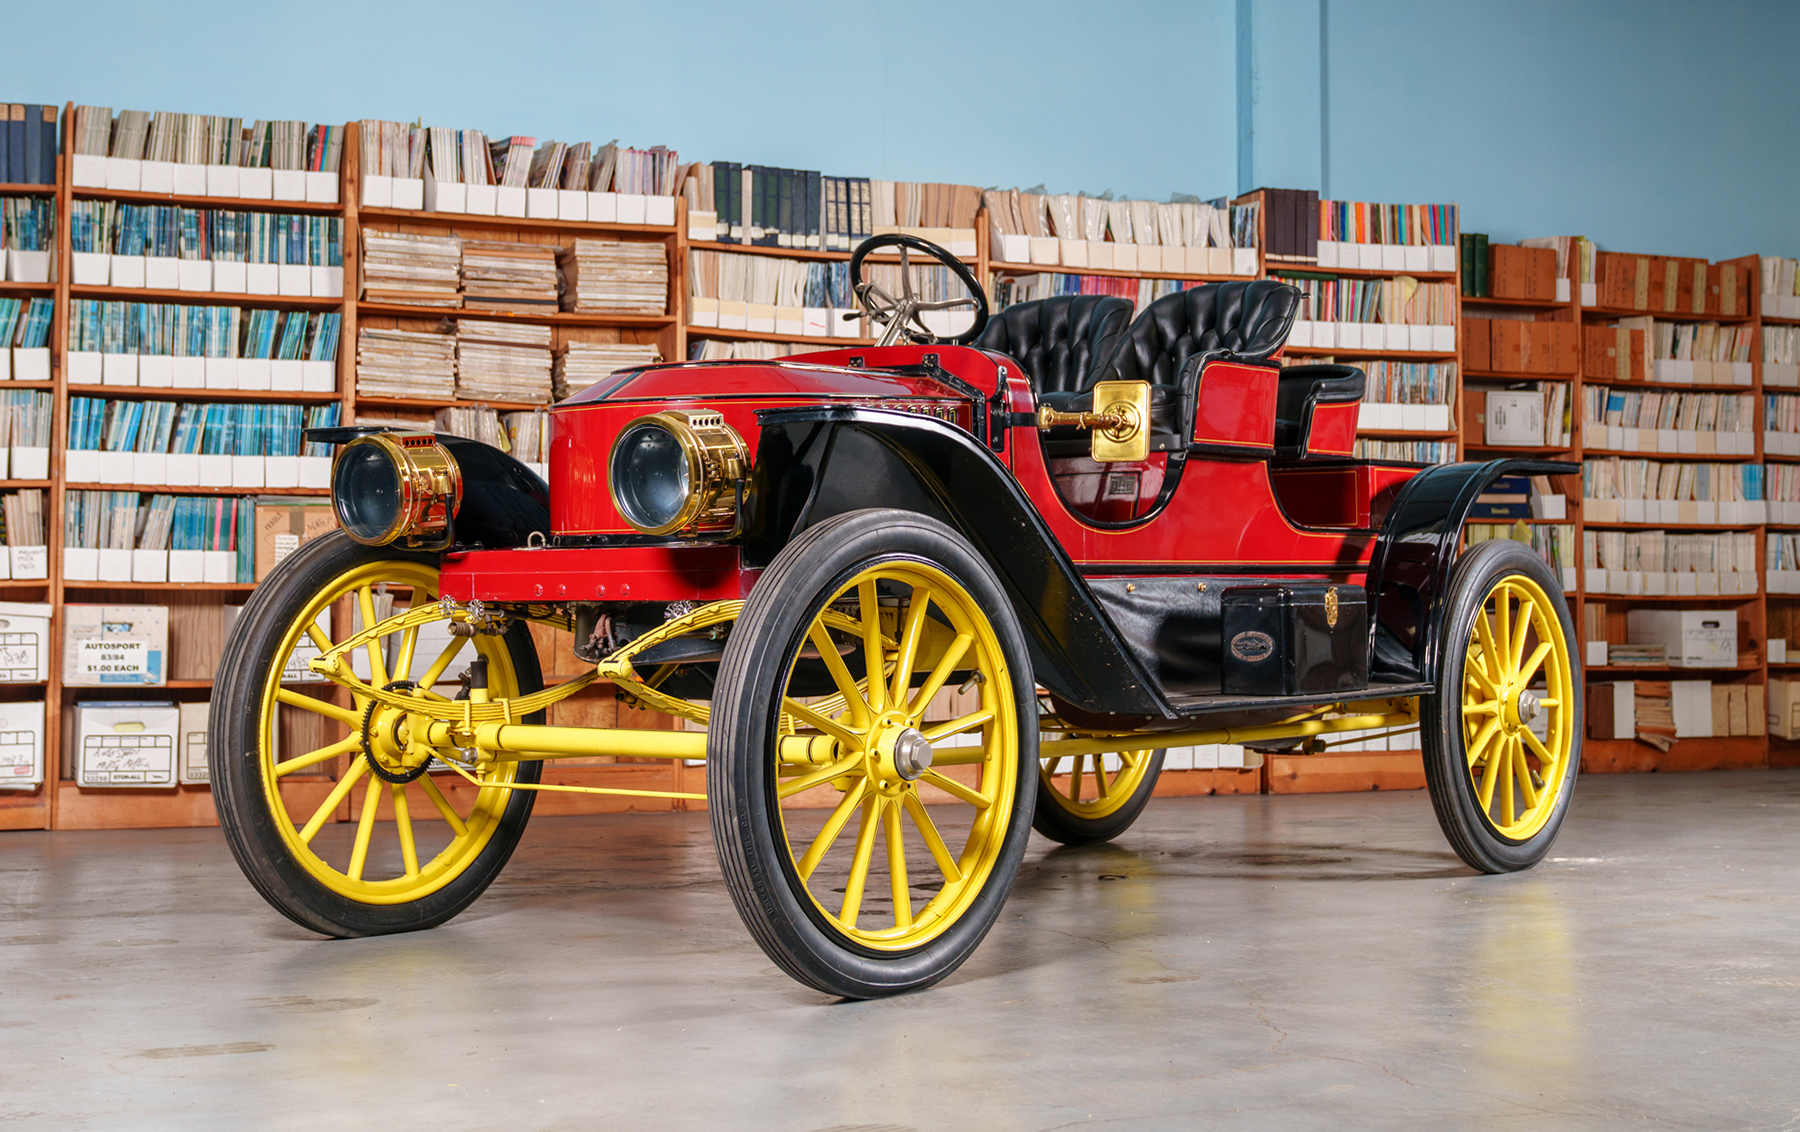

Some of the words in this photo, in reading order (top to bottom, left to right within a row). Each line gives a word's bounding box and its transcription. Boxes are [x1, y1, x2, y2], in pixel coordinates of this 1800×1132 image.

[264, 511, 284, 532] FRAGILE
[87, 664, 112, 672] $1.00
[744, 833, 754, 857] TIRE
[750, 861, 775, 915] UNIVERSAL
